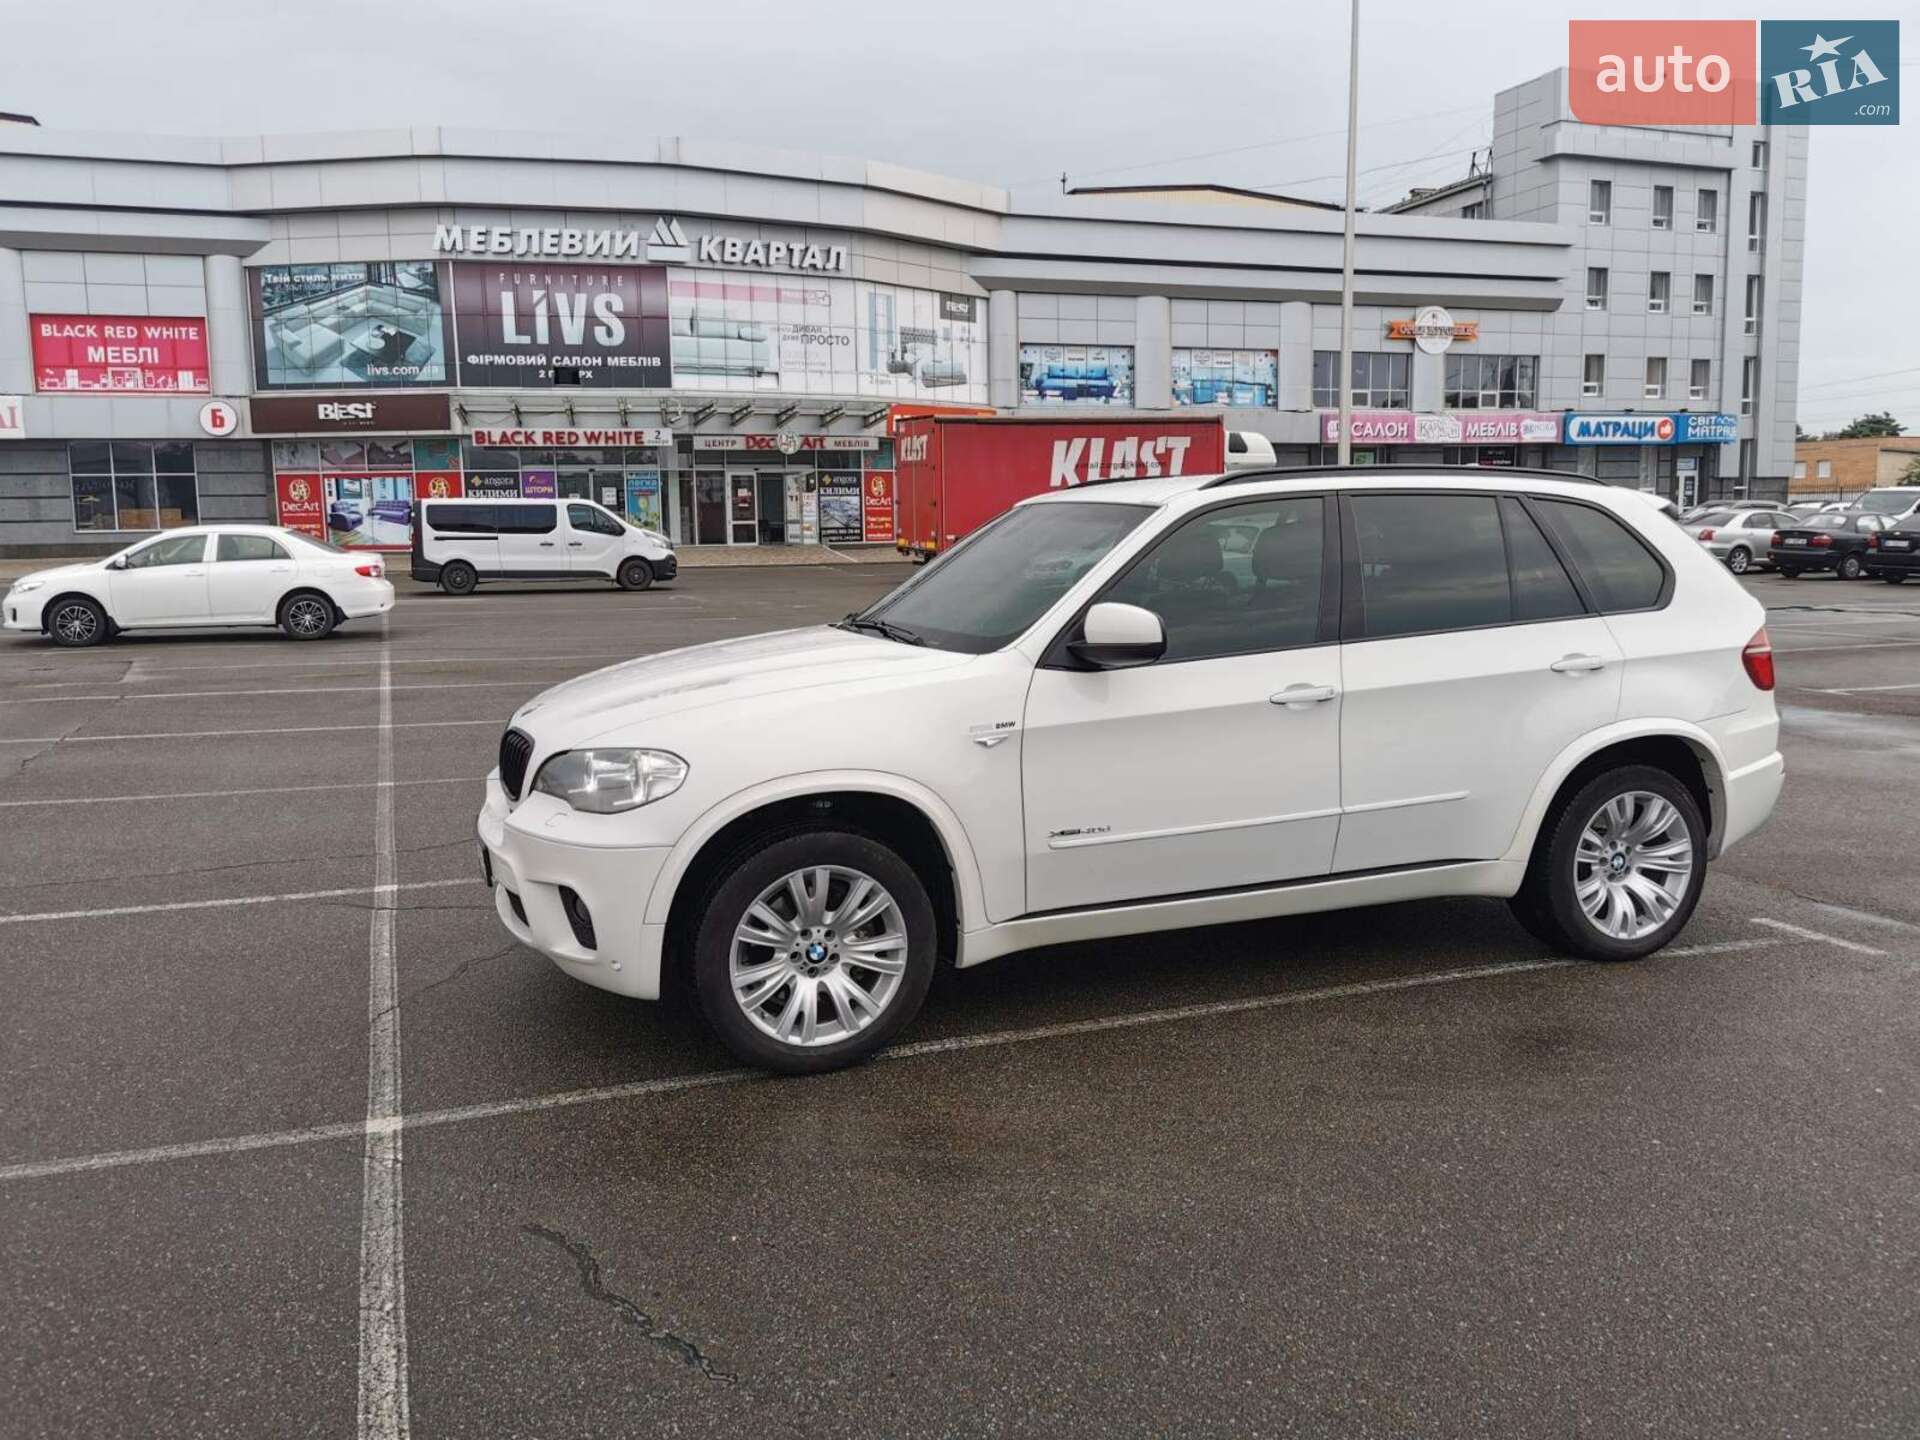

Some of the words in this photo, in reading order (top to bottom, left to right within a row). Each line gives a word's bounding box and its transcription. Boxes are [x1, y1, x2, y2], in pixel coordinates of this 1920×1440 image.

[698, 235, 847, 271] КВАРТАЛ
[499, 273, 624, 287] FURNITURE
[41, 323, 98, 338] BLACK
[104, 325, 138, 339] RED
[144, 326, 199, 340] WHITE
[801, 334, 850, 346] ПРОСТО
[87, 346, 159, 363] МЕБЛІ
[466, 353, 547, 367] ФІРМОВИЙ
[552, 355, 602, 367] САЛОН
[607, 356, 662, 367] МЕБЛІВ
[538, 370, 546, 378] 2
[474, 430, 537, 445] BLACK
[542, 431, 579, 445] RED
[583, 431, 644, 445] WHITE
[1351, 422, 1408, 438] САЛОН
[1466, 422, 1518, 437] МЕБЛІВ
[1576, 421, 1656, 439] МАТРАЦИ
[704, 439, 737, 448] ЦЕНТР
[833, 440, 870, 448] МЕБЛІВ
[1050, 436, 1191, 487] KLAST
